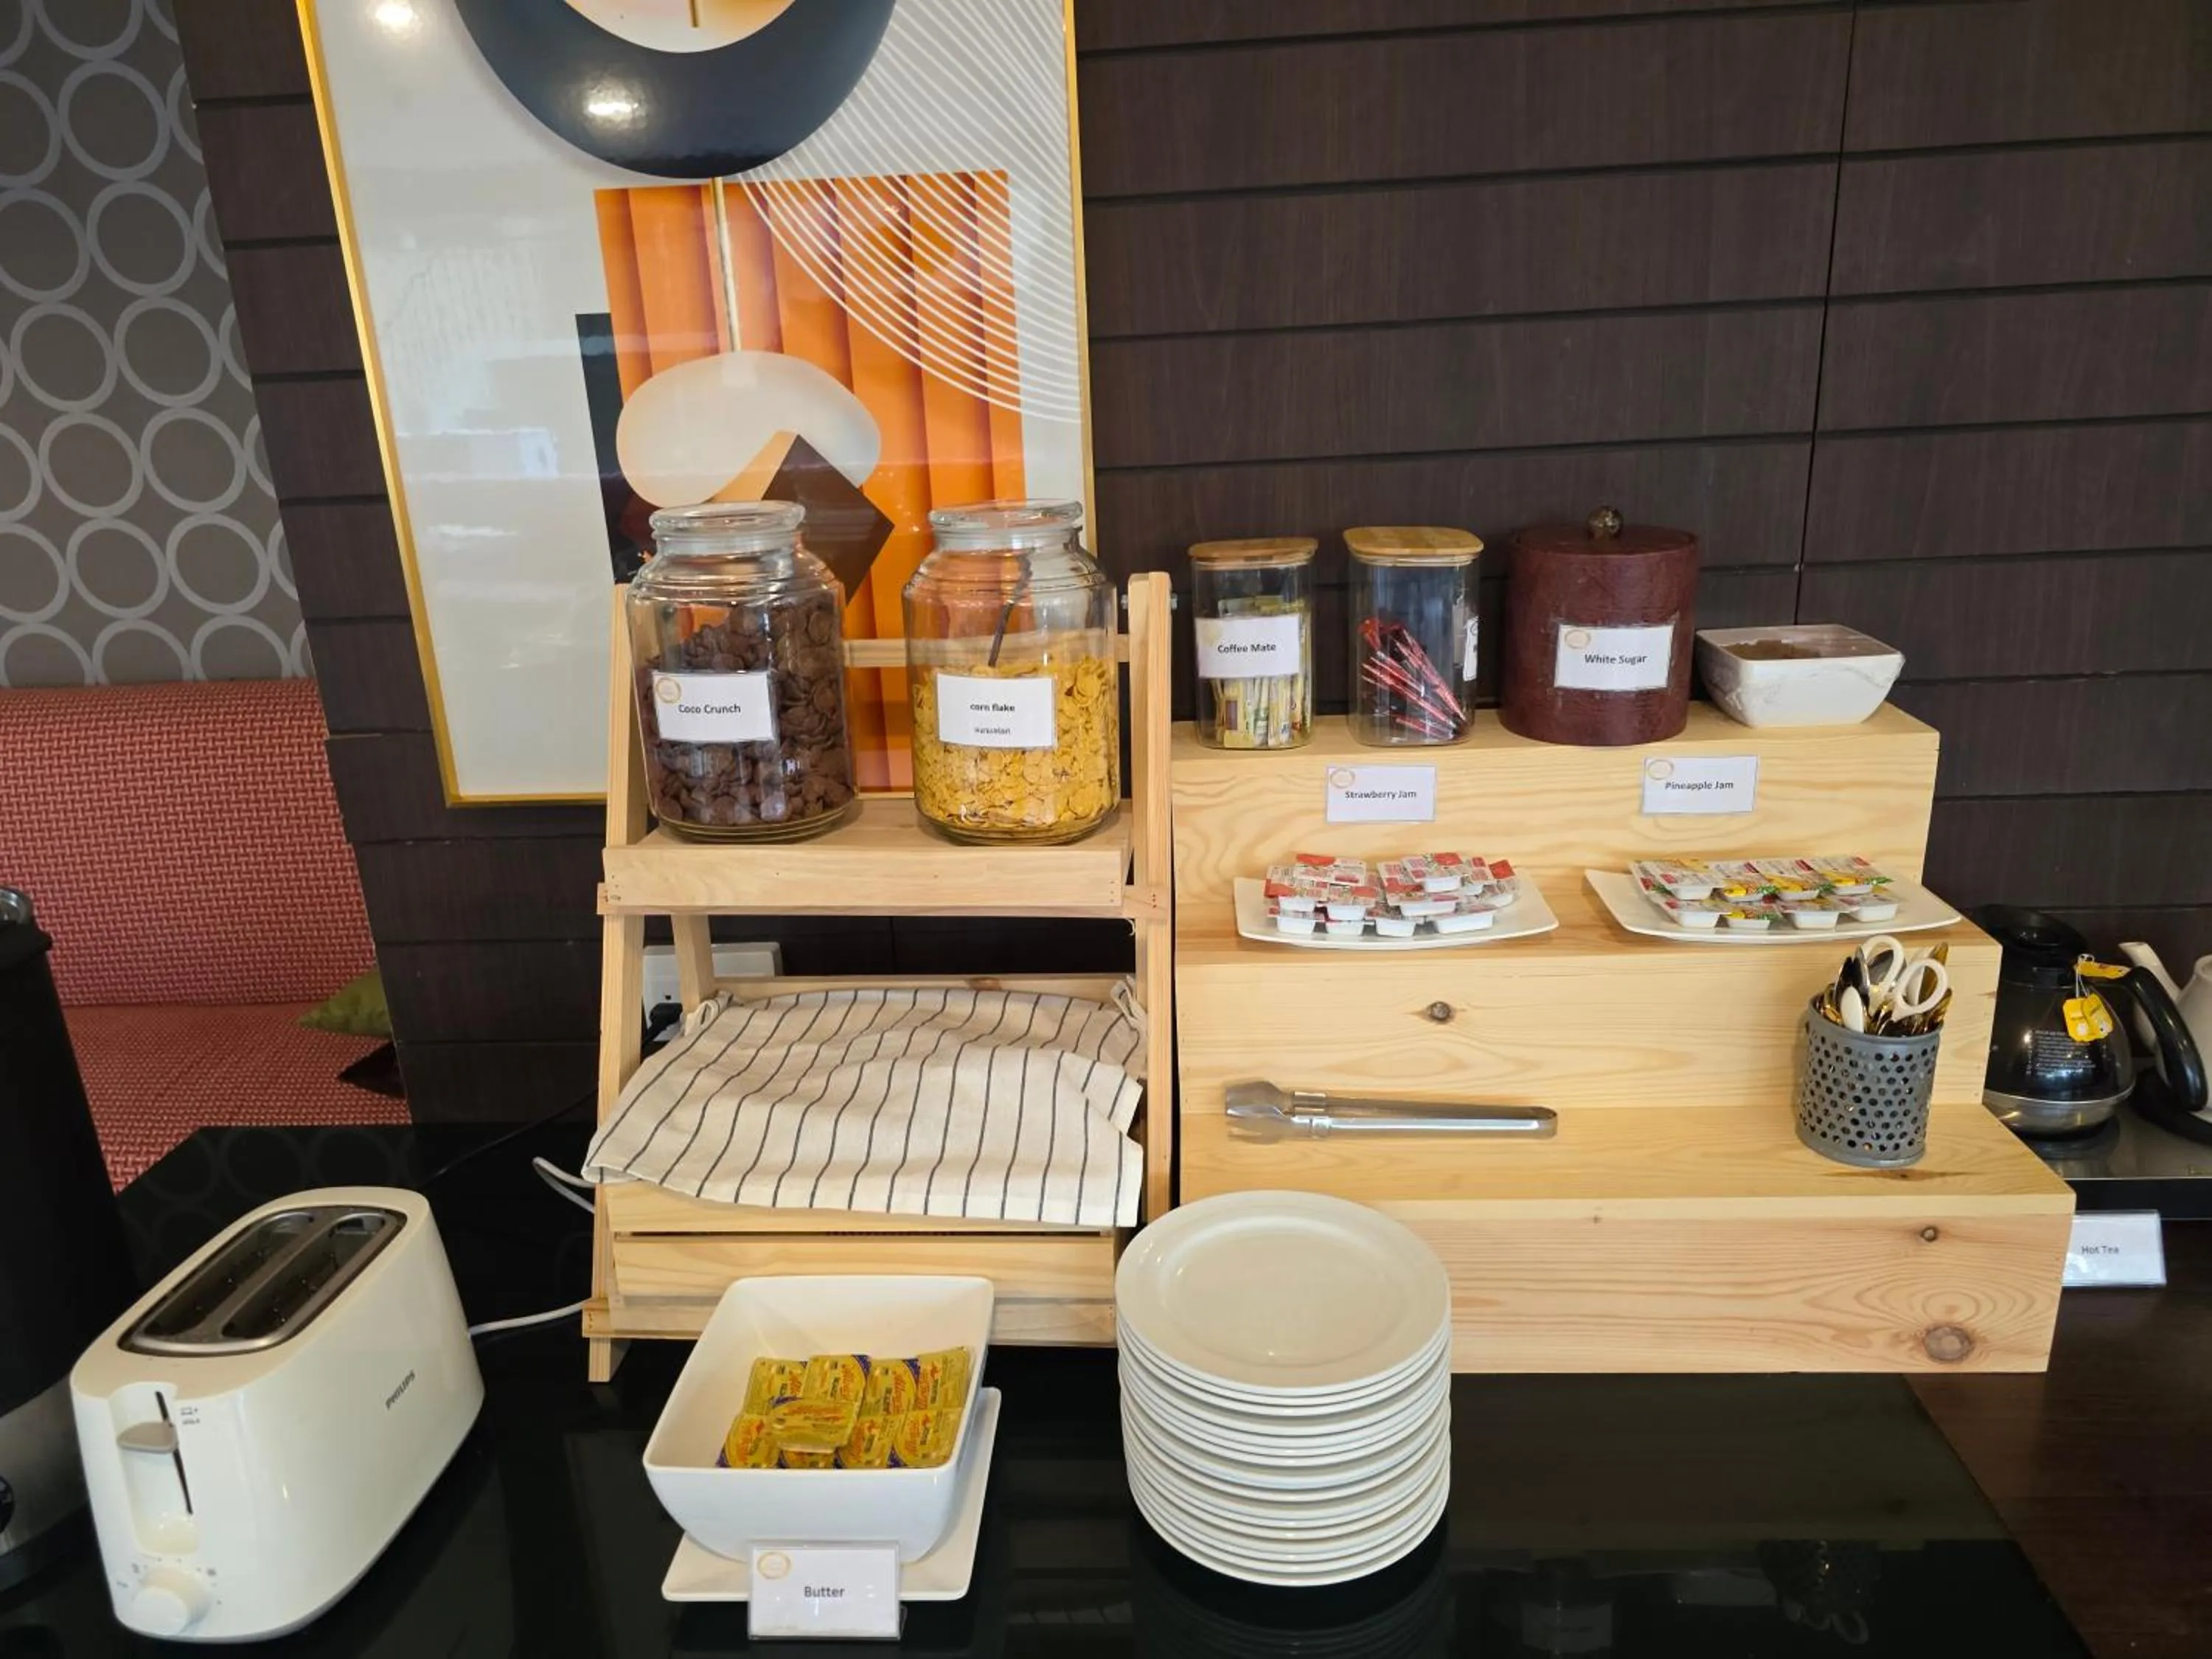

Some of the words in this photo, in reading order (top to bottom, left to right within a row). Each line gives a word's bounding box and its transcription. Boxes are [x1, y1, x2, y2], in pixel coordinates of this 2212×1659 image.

[1217, 644, 1248, 654] Coffee
[1251, 643, 1276, 653] Mate
[1585, 654, 1616, 664] White
[1618, 654, 1648, 665] Sugar
[678, 704, 701, 714] Coco
[703, 703, 741, 714] Crunch
[970, 703, 990, 712] corn
[992, 703, 1015, 712] flake
[1665, 781, 1712, 791] Pineapple
[1714, 781, 1734, 790] Jam
[1344, 790, 1396, 800] Strawberry
[1398, 790, 1417, 799] Jam
[2081, 1245, 2100, 1254] Hot
[2101, 1245, 2119, 1254] Tea
[385, 1369, 415, 1411] PHILIPS
[804, 1586, 846, 1598] Butter
